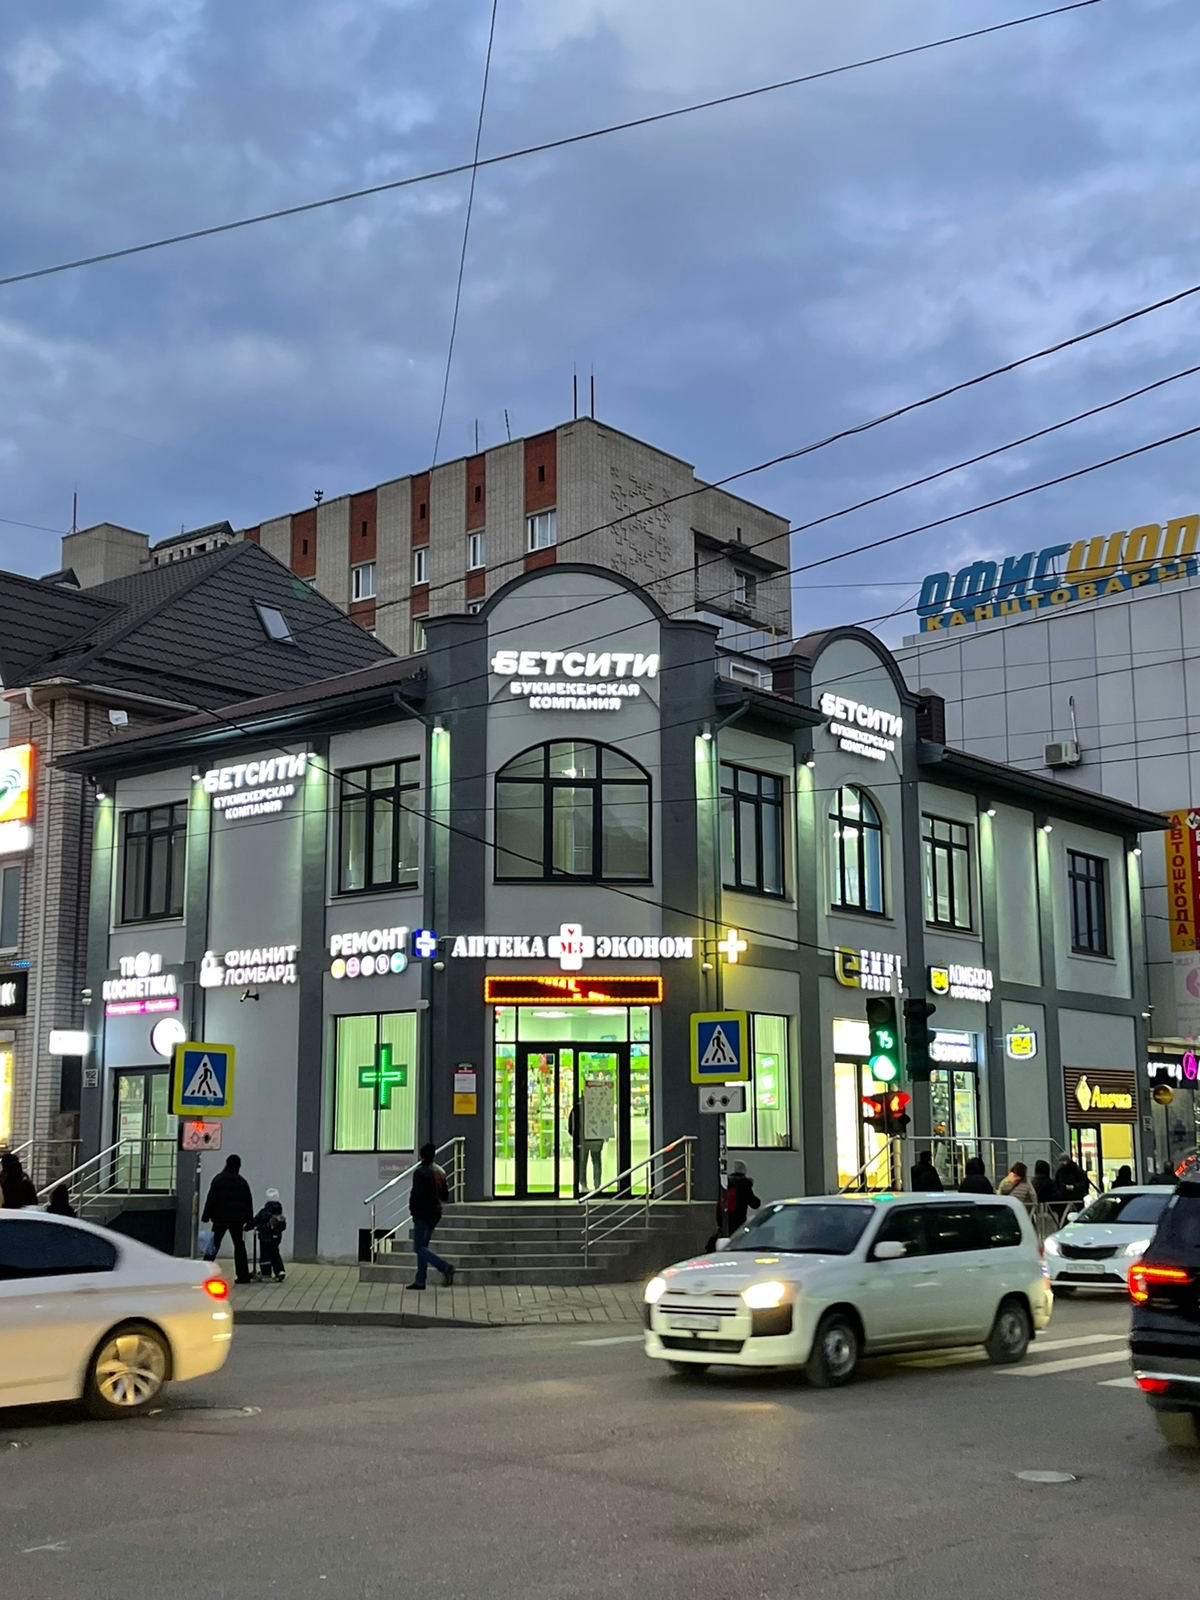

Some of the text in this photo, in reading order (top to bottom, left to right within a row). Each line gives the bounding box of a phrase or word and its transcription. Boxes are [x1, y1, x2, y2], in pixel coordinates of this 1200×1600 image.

[926, 563, 1187, 632] КАНЦТОВАРЫ
[490, 650, 660, 678] БЕТСИТИ
[510, 682, 641, 697] БУКМЕКЕРСКАЯ
[529, 696, 622, 711] КОМПАНИЯ
[820, 692, 903, 738] БЕТСИТИ
[830, 722, 895, 752] БУКМЕКЕРСКАЯ
[840, 738, 886, 762] КОМПАНИЯ
[202, 752, 307, 793] БЕТСИТИ
[213, 784, 295, 810] БУКМЕКЕРСКАЯ
[225, 800, 283, 820] КОМПАНИЯ
[1170, 814, 1189, 936] АВТОШКОЛА
[330, 926, 409, 957] РЕМОНТ
[451, 935, 546, 958] АПТЕКА
[596, 935, 693, 958] ЭКОНОМ
[224, 945, 297, 967] ФИАНИТ
[102, 974, 177, 1001] КОСМЕТИКА
[224, 963, 297, 987] ЛОМБАРД
[861, 974, 903, 994] PERFUE
[949, 964, 993, 990] ЛОМБАРД
[1011, 1036, 1032, 1054] 24
[1091, 1085, 1132, 1109] Анечка
